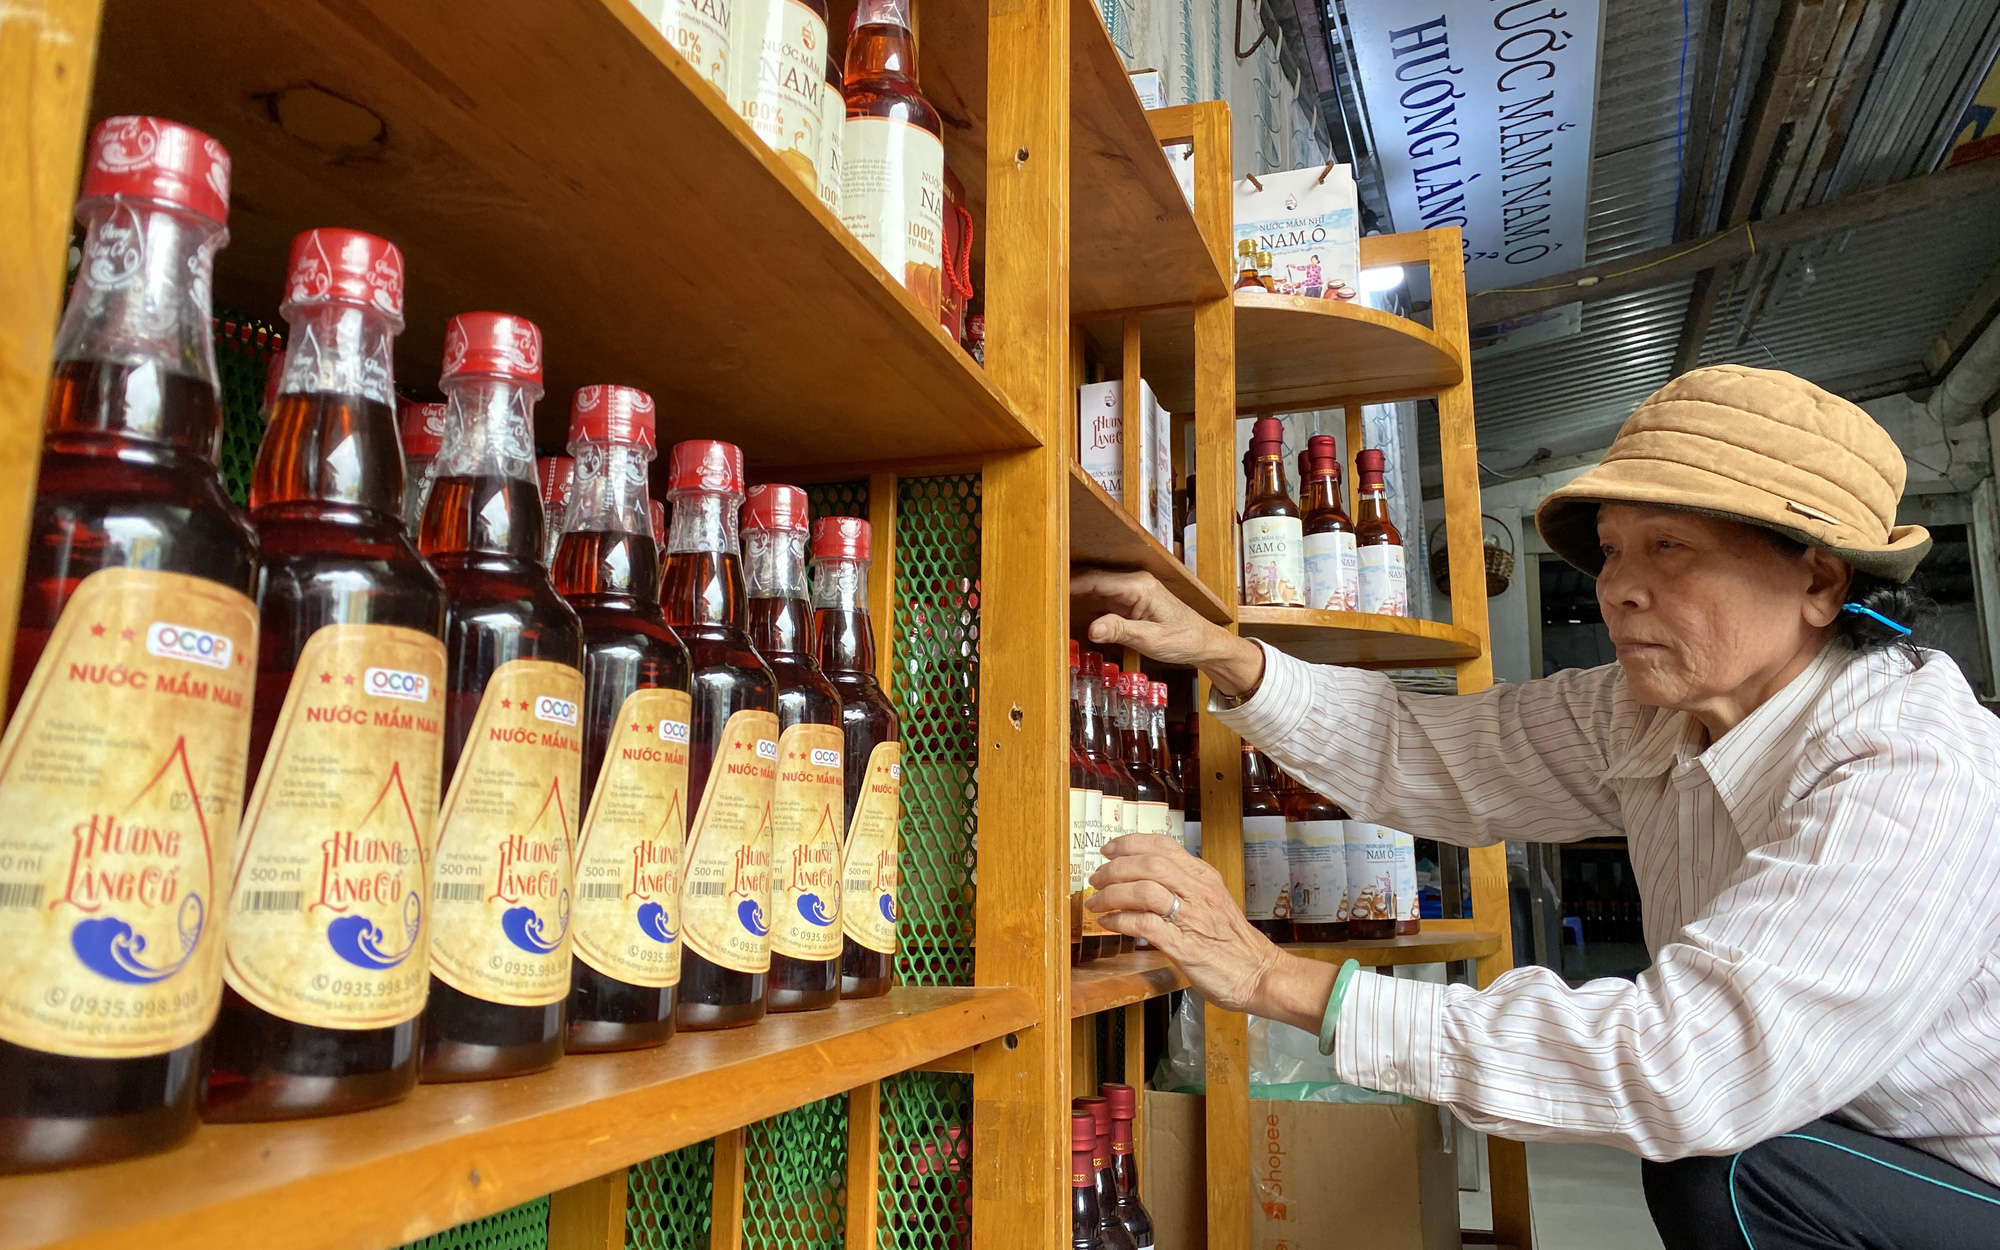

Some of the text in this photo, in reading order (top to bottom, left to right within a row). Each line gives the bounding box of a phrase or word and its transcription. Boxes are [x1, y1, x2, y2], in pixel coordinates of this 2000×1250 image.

[759, 57, 818, 106] NAM
[1389, 14, 1466, 160] HƯƠNG
[742, 100, 784, 124] 100%
[1490, 0, 1576, 265] ƯỚC MẮM NAM Ô
[920, 186, 942, 219] NA
[908, 220, 935, 245] 100%
[1259, 224, 1326, 250] NAM Ô
[1093, 415, 1124, 432] HƯƠN
[1248, 543, 1274, 554] NAM
[158, 627, 227, 658] OCOP
[69, 662, 147, 689] NƯỚC
[156, 671, 209, 700] MẮM
[373, 671, 424, 694] OCOP
[306, 705, 368, 725] NƯỚC
[374, 706, 413, 730] MẮM
[541, 699, 575, 718] OCOP
[490, 727, 537, 745] NƯỚC
[541, 729, 568, 748] MẮM
[760, 741, 777, 755] OCO
[622, 747, 684, 765] NƯỚC MẮM
[815, 750, 838, 763] OCOP
[728, 763, 758, 776] NƯỚC
[782, 771, 814, 782] NƯỚC
[816, 772, 835, 785] MẮM
[871, 784, 893, 794] NƯỚC
[72, 814, 182, 859] HƯƠNG
[321, 831, 401, 868] HƯƠNG
[499, 834, 558, 866] HƯƠNG
[633, 840, 678, 868] HƯƠNG
[735, 845, 770, 868] HƯƠNG
[792, 844, 832, 866] HƯƠNG
[1366, 850, 1386, 860] NAM
[249, 867, 301, 881] 500 ml
[440, 863, 482, 876] 500 ml
[585, 867, 621, 877] 500 ml
[694, 867, 724, 877] 500 ml
[861, 868, 871, 876] ml
[1262, 1114, 1287, 1196] Shopee
